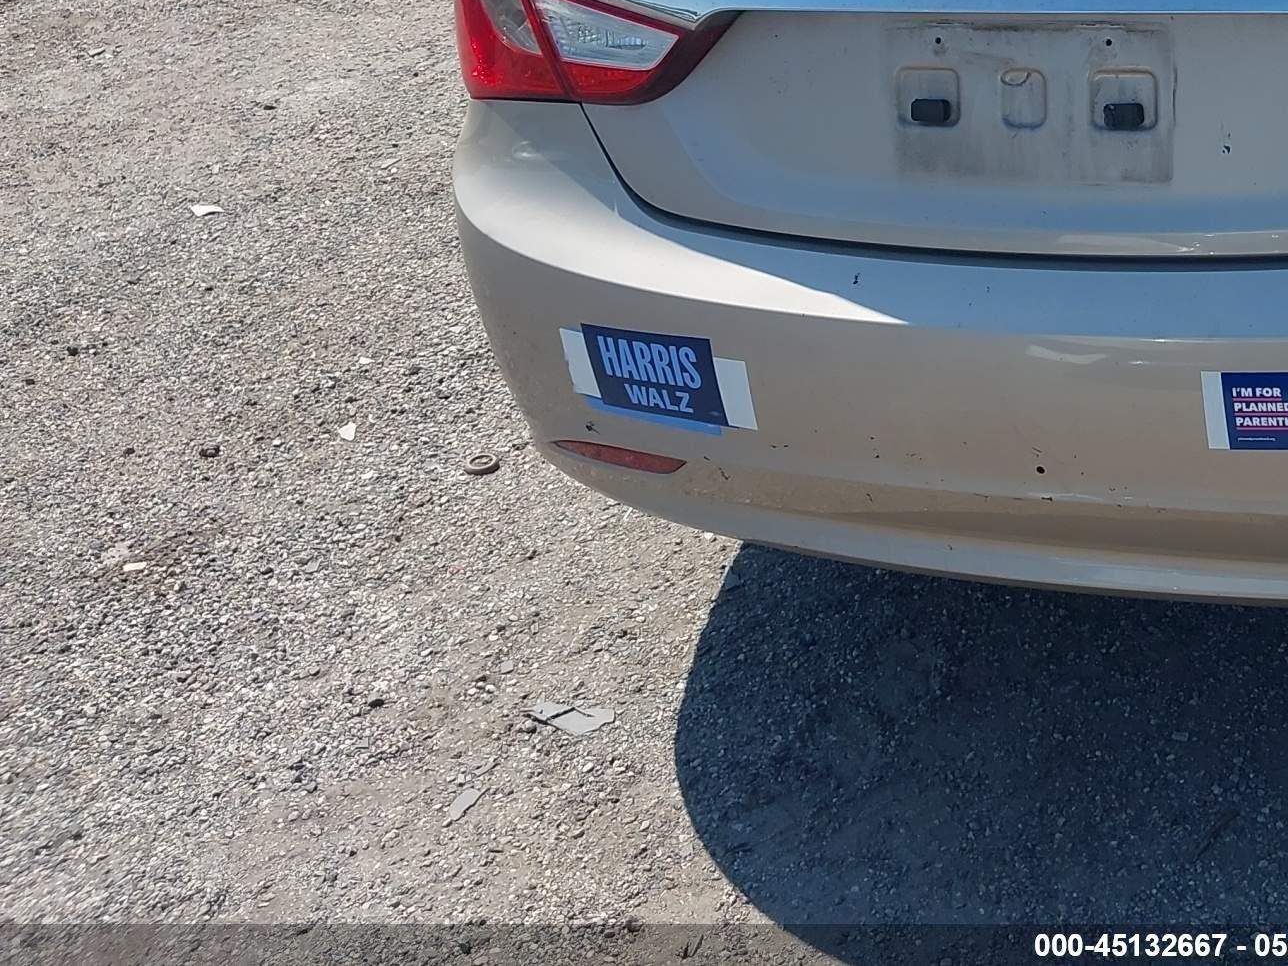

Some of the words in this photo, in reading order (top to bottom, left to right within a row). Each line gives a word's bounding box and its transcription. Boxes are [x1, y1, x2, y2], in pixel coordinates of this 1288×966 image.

[596, 334, 703, 390] HARRIS
[624, 383, 694, 414] WALZ
[1232, 387, 1253, 398] I'M
[1255, 387, 1282, 398] FOR
